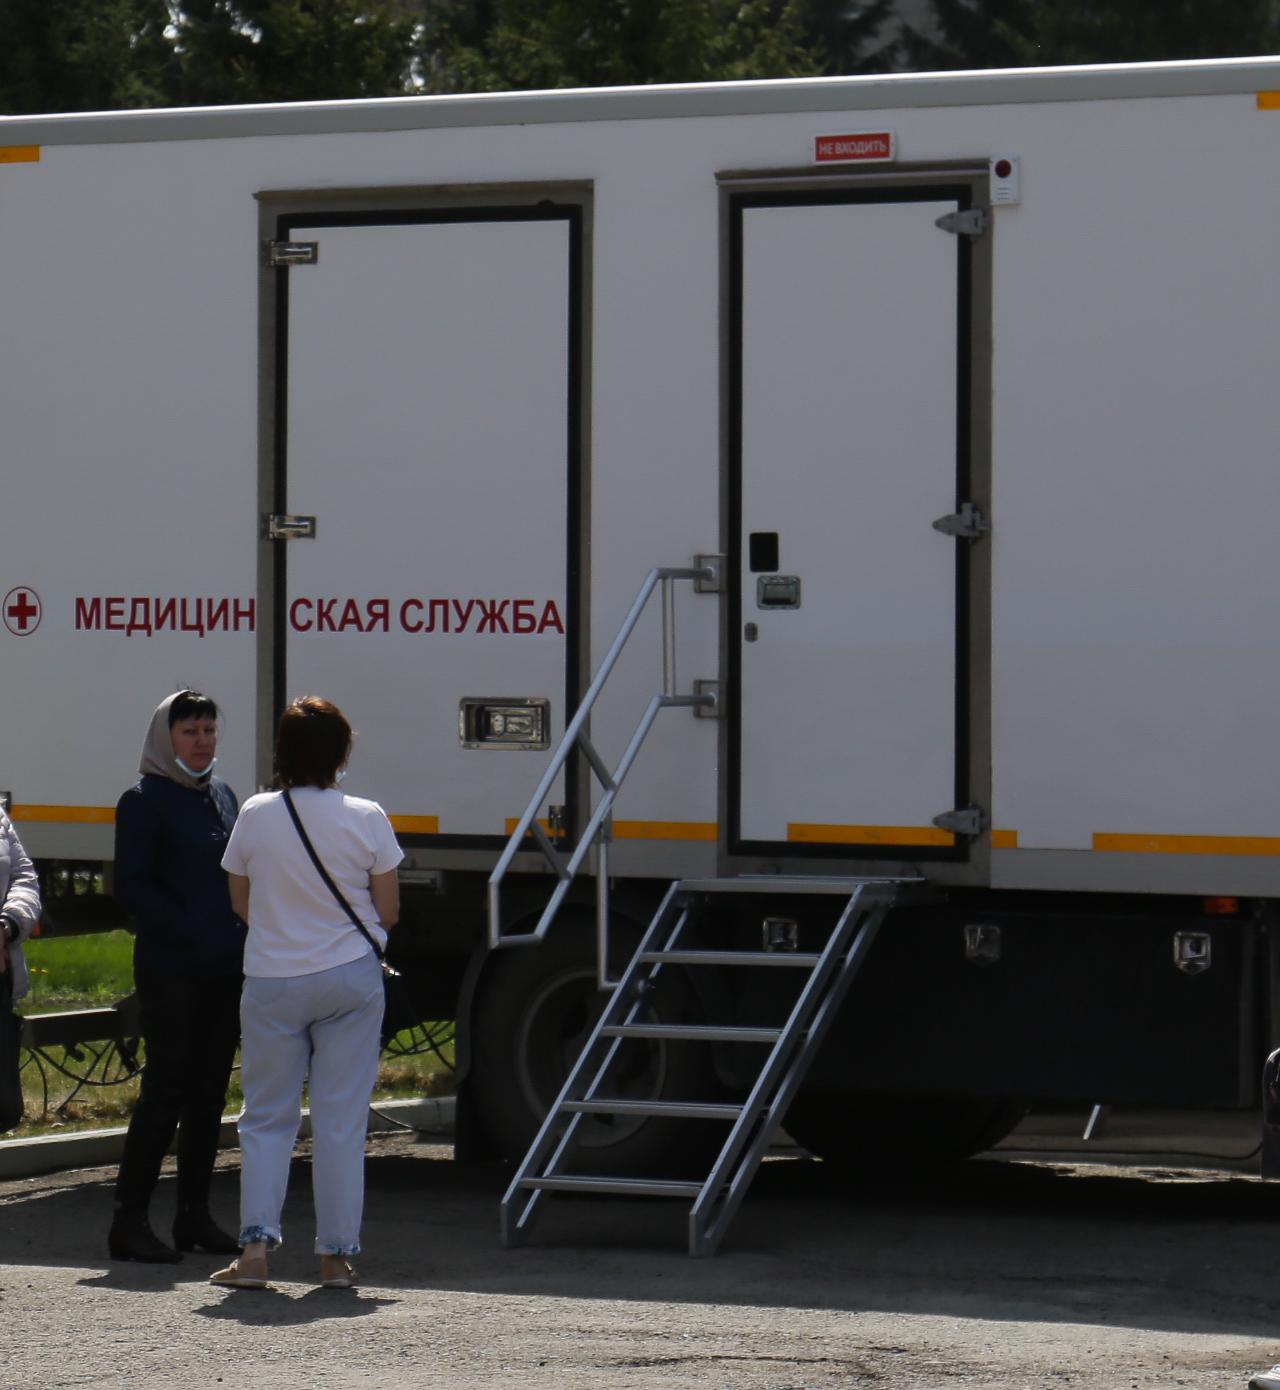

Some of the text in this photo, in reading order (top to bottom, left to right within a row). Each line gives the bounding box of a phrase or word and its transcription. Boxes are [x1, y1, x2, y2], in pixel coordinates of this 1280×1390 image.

[818, 139, 887, 155] НЕ ВХОДИТЬ
[400, 597, 563, 634] СЛУЖБА
